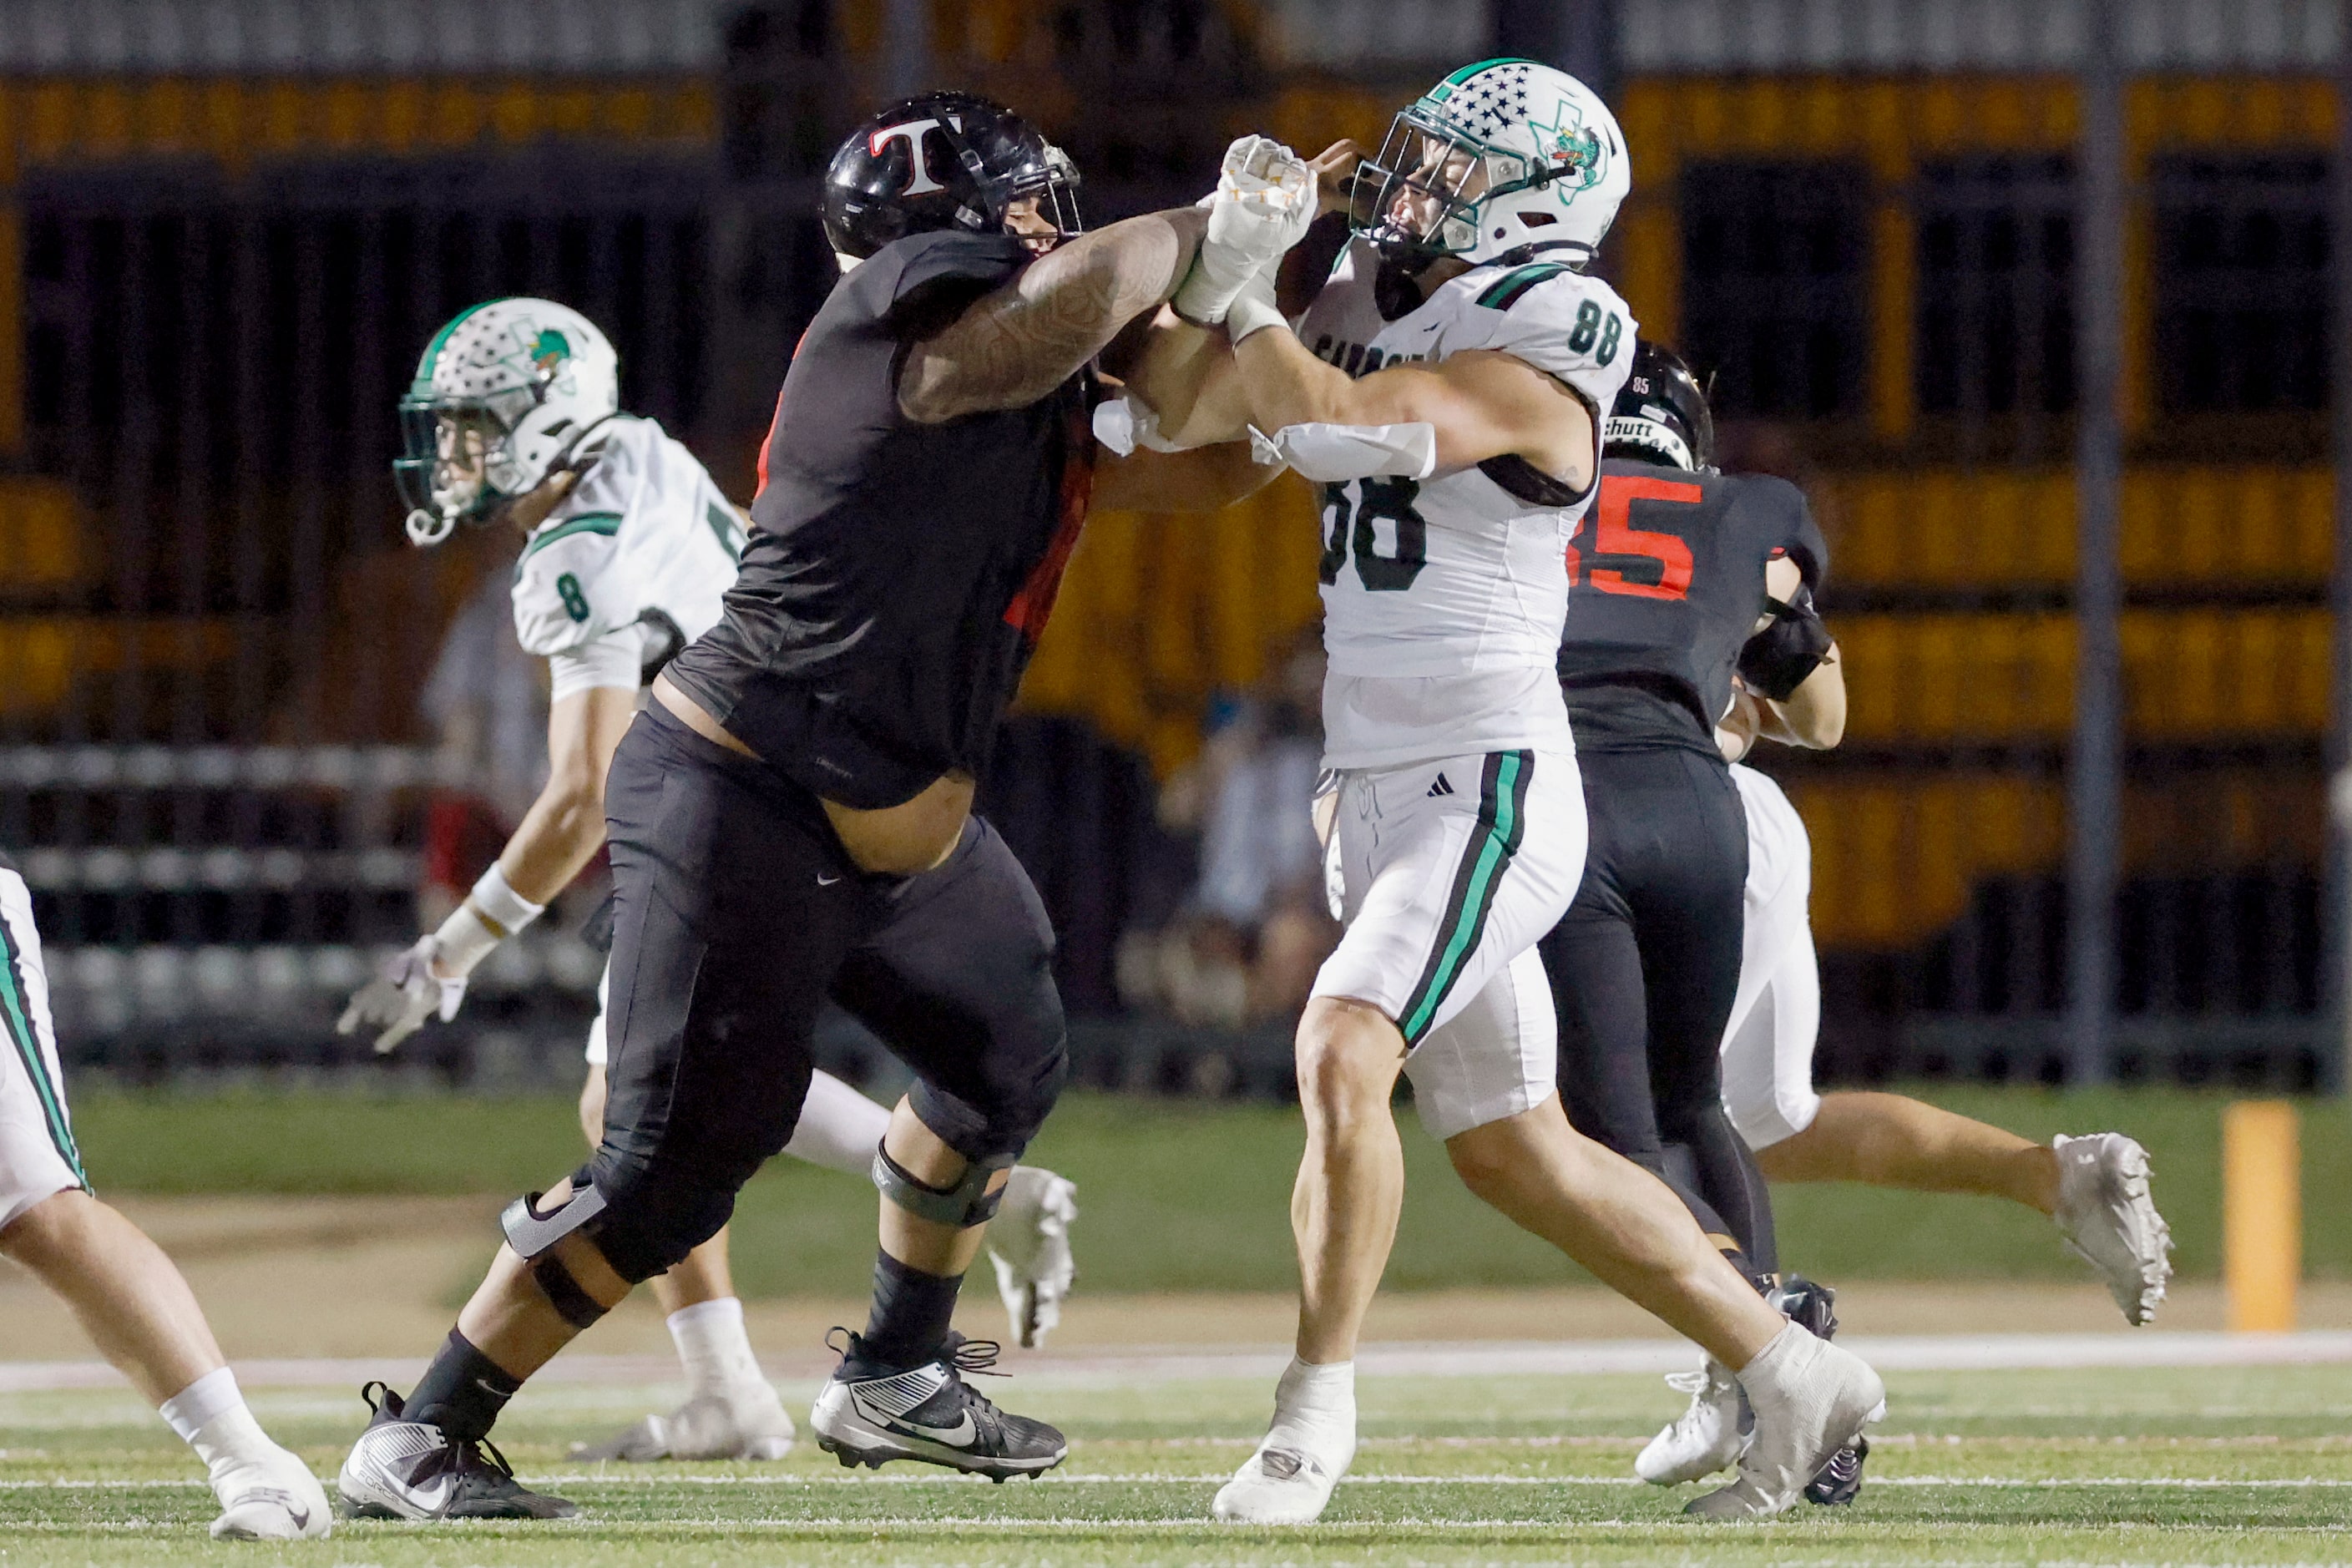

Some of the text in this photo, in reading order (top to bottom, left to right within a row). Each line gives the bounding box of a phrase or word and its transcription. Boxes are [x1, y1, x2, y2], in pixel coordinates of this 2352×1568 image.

[869, 114, 962, 198] T
[1568, 298, 1621, 368] 88
[1632, 377, 1649, 394] 85
[1565, 475, 1702, 600] 5
[557, 571, 589, 622] 8
